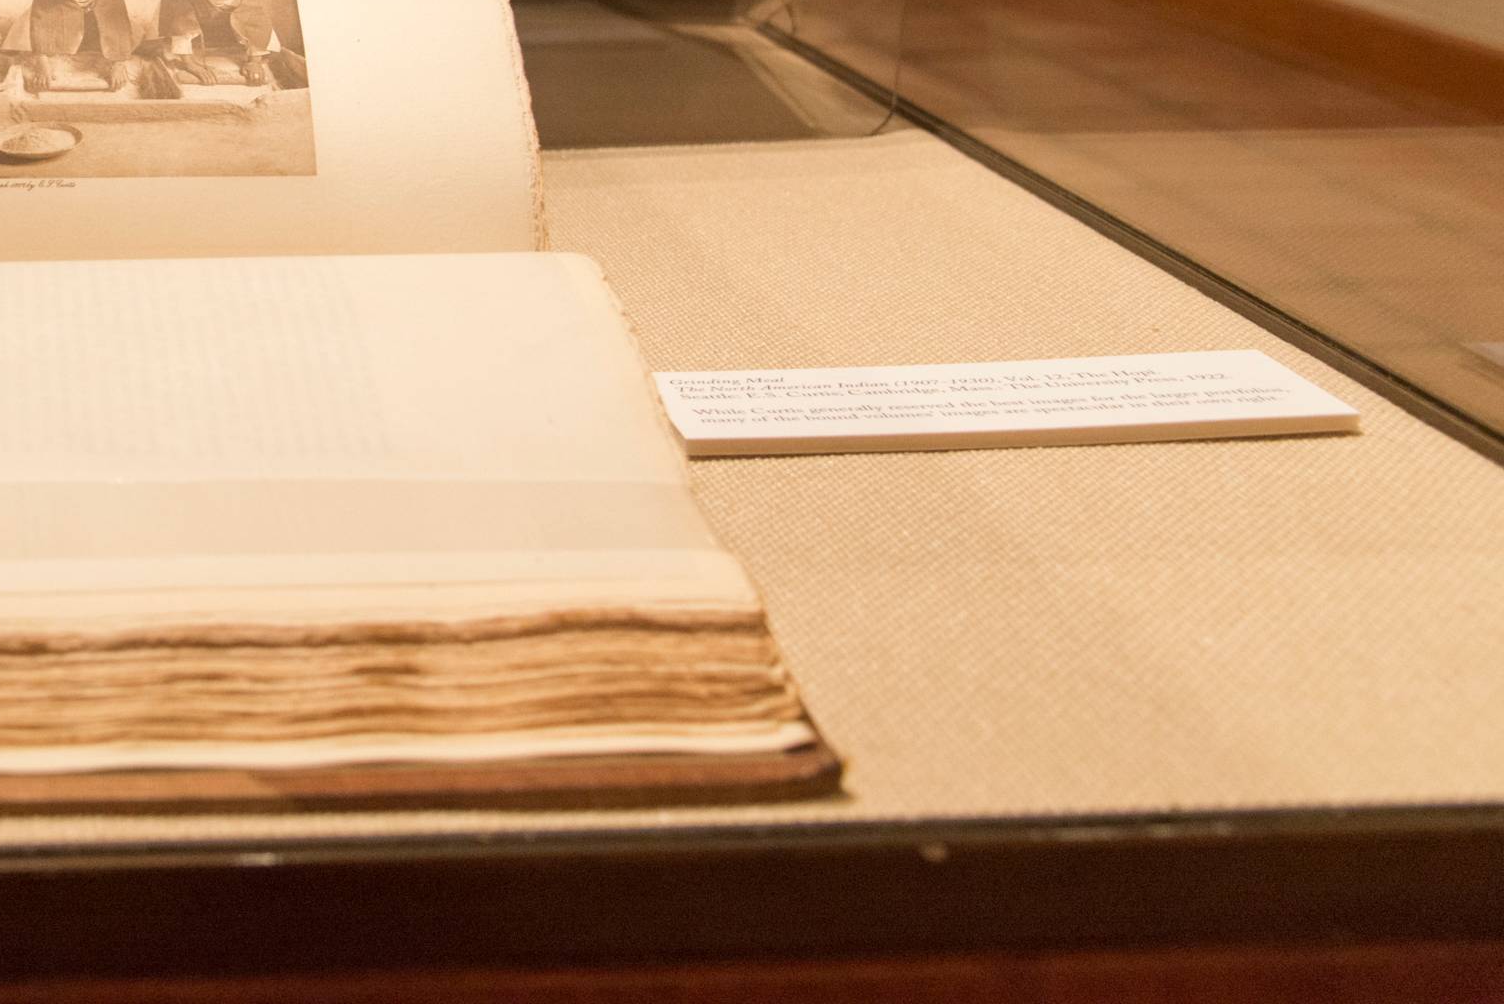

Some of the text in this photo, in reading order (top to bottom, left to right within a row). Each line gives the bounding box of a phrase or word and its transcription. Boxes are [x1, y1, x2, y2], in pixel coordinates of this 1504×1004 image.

[670, 378, 742, 386] Grinding
[1004, 382, 1041, 390] The
[1043, 379, 1129, 388] University
[692, 407, 745, 415] While
[808, 404, 882, 414] generally
[887, 402, 955, 410] reserved
[960, 400, 985, 408] the
[1028, 397, 1087, 405] images
[700, 417, 745, 425] many
[804, 413, 859, 421] bound
[939, 409, 998, 417] images
[1033, 403, 1123, 413] spectacular
[1151, 399, 1190, 407] their
